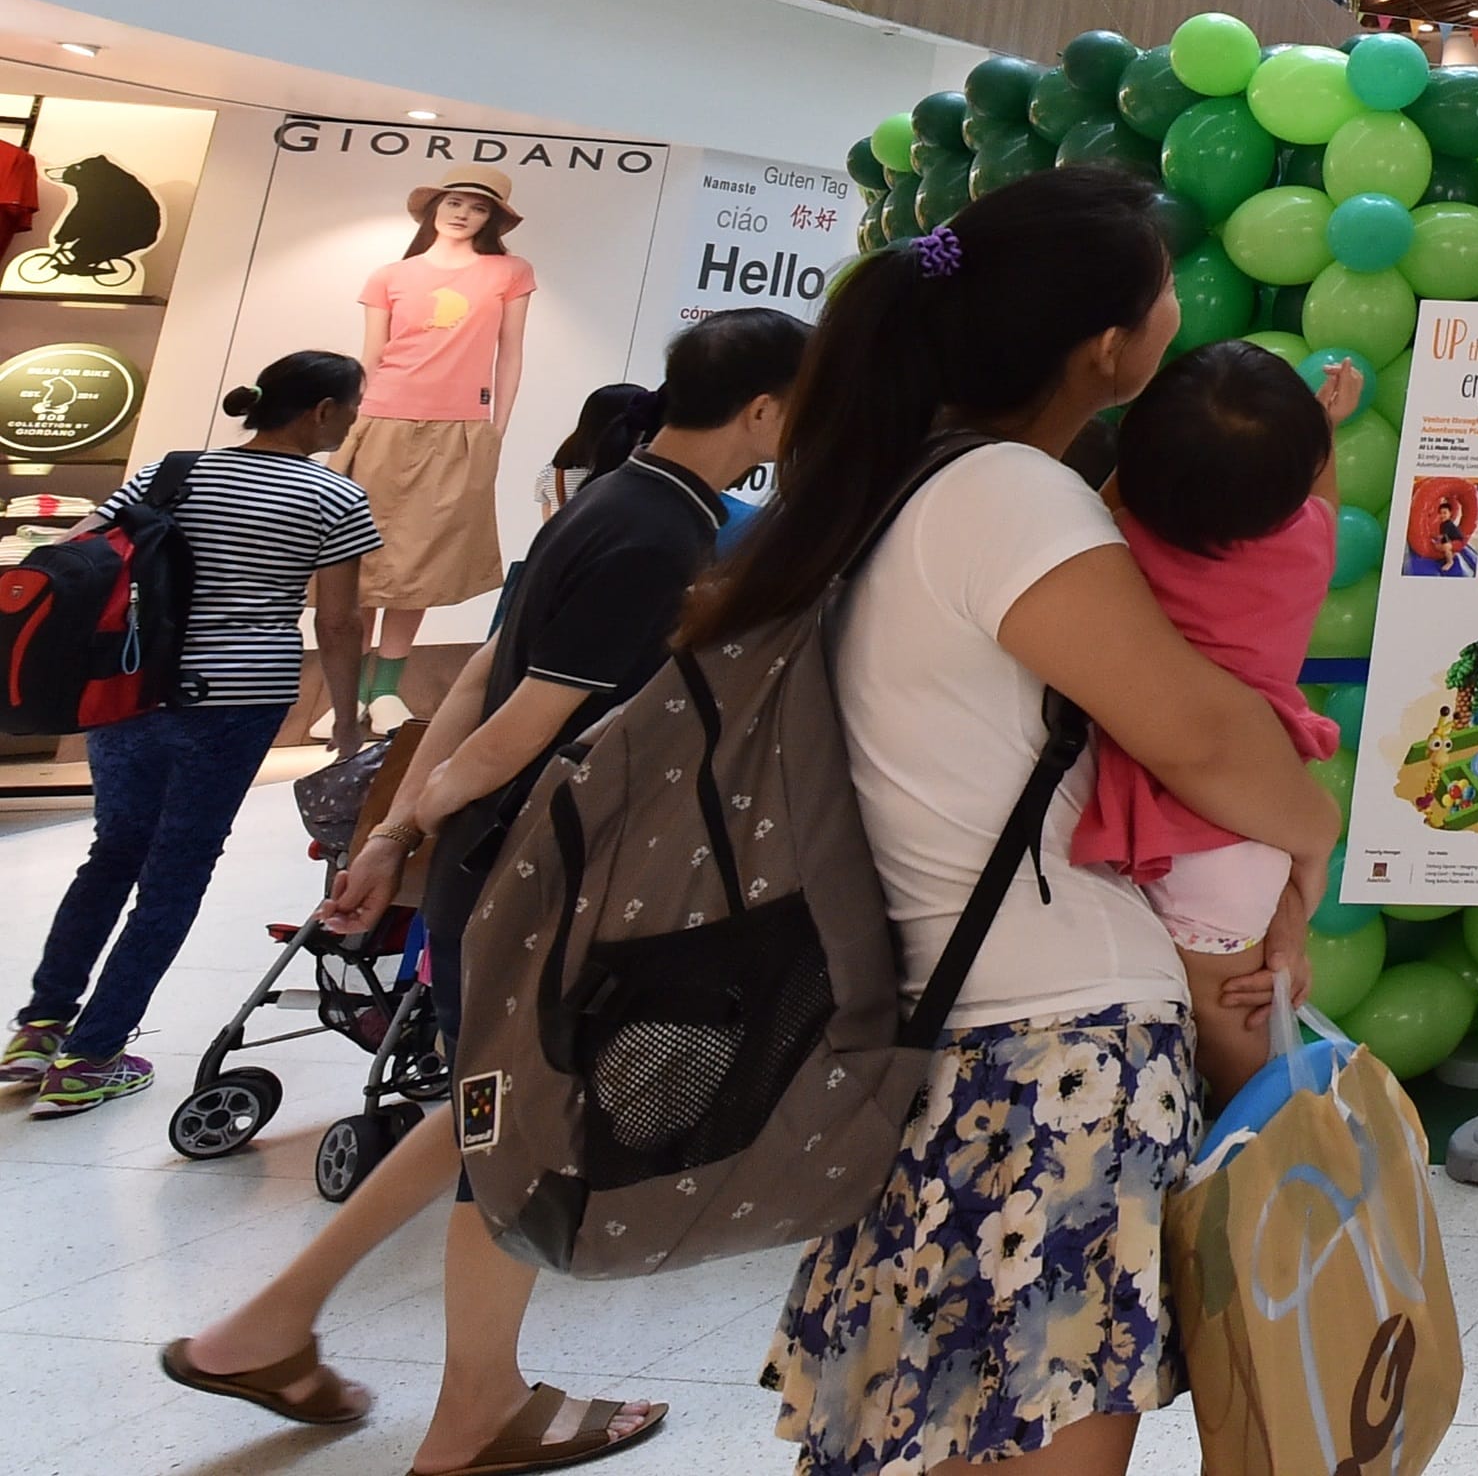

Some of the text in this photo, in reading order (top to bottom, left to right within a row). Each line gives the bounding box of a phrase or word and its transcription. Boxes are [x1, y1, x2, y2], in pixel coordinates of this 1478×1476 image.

[273, 120, 653, 174] GIORDANO
[702, 175, 757, 195] Namaste
[764, 166, 849, 200] Guten Tag
[789, 204, 838, 232] 你好
[697, 242, 825, 301] Hello
[1433, 318, 1468, 360] UP
[82, 369, 111, 377] BIKE
[15, 428, 76, 436] GIORDANO
[1422, 416, 1451, 424] Venture
[1422, 426, 1467, 435] Adventurous
